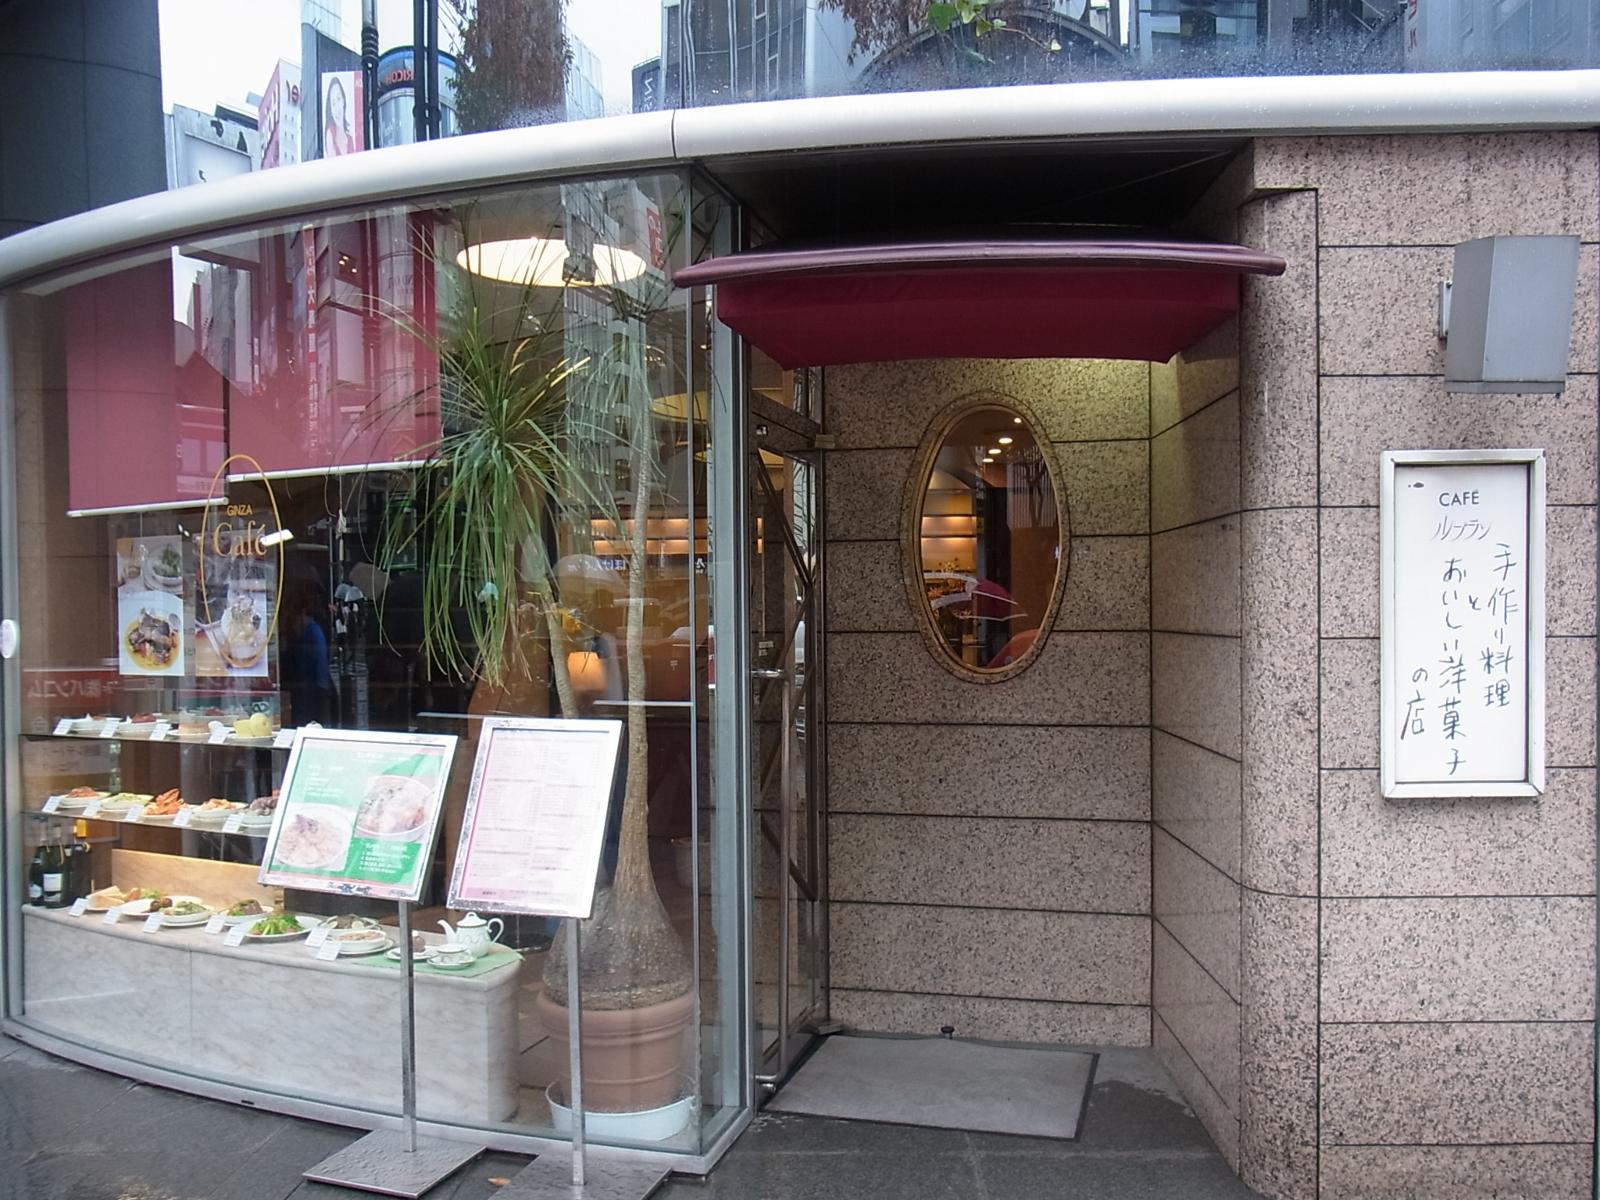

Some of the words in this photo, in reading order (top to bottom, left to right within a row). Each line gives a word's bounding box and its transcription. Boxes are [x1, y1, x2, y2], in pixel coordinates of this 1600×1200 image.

[213, 520, 267, 558] Café
[226, 504, 253, 516] GINZA
[1479, 543, 1519, 707] 手作り料理
[1400, 667, 1428, 740] の店
[1438, 558, 1467, 776] おいしい洋菓子
